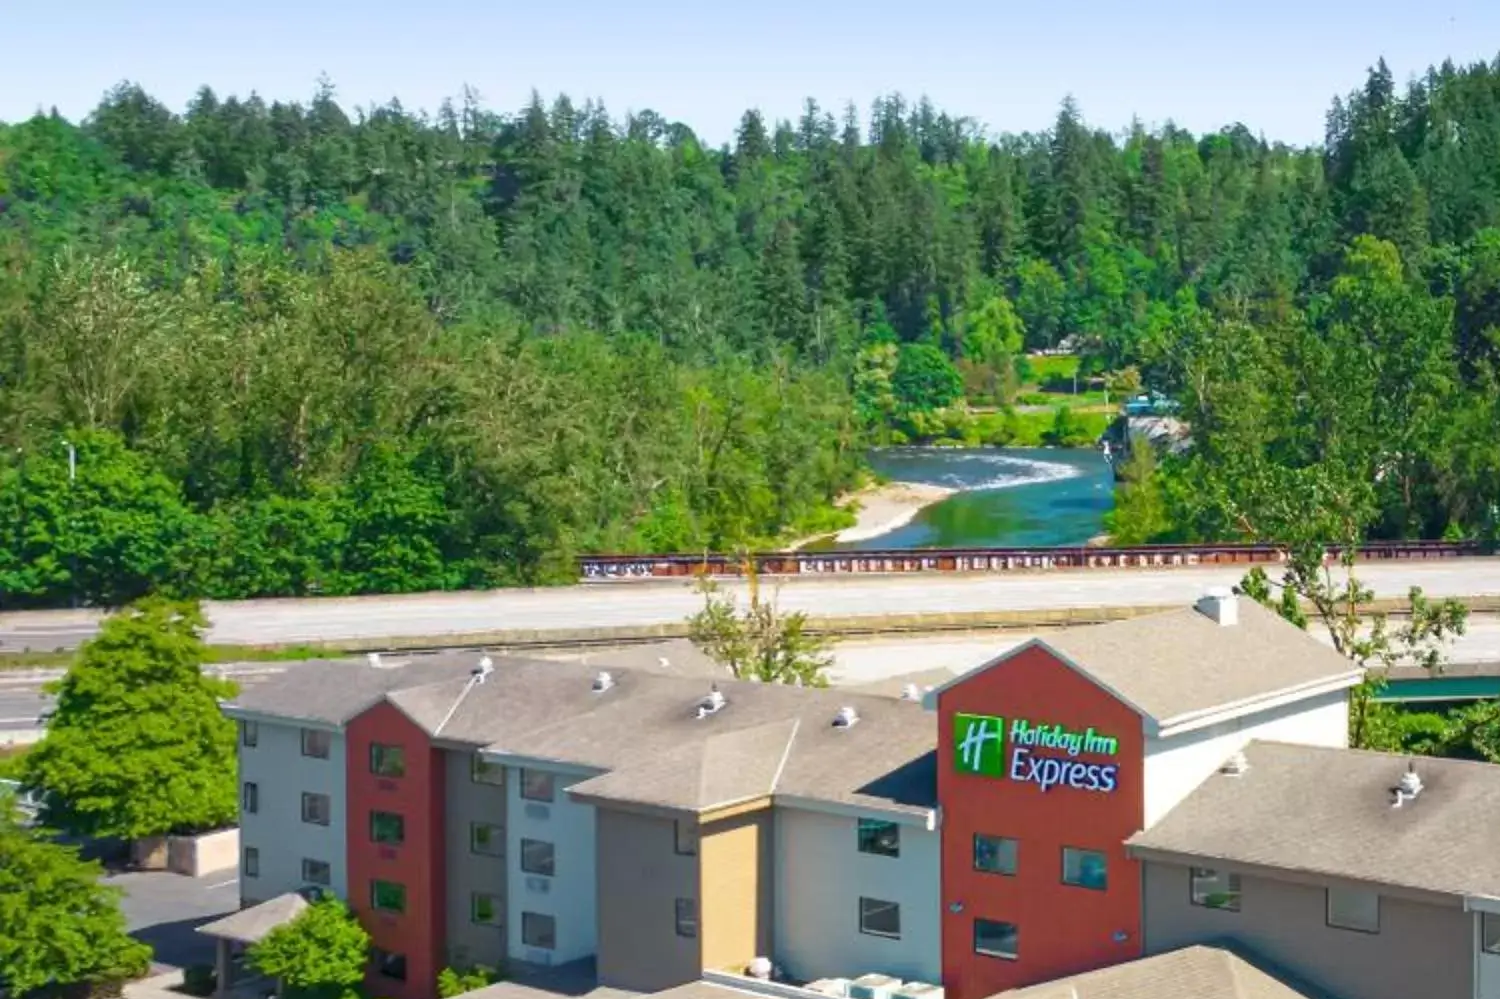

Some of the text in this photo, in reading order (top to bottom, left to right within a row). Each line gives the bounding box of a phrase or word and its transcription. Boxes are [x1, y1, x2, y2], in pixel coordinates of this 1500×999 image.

[1009, 719, 1118, 757] Holiday Inn
[1010, 747, 1117, 792] Express
